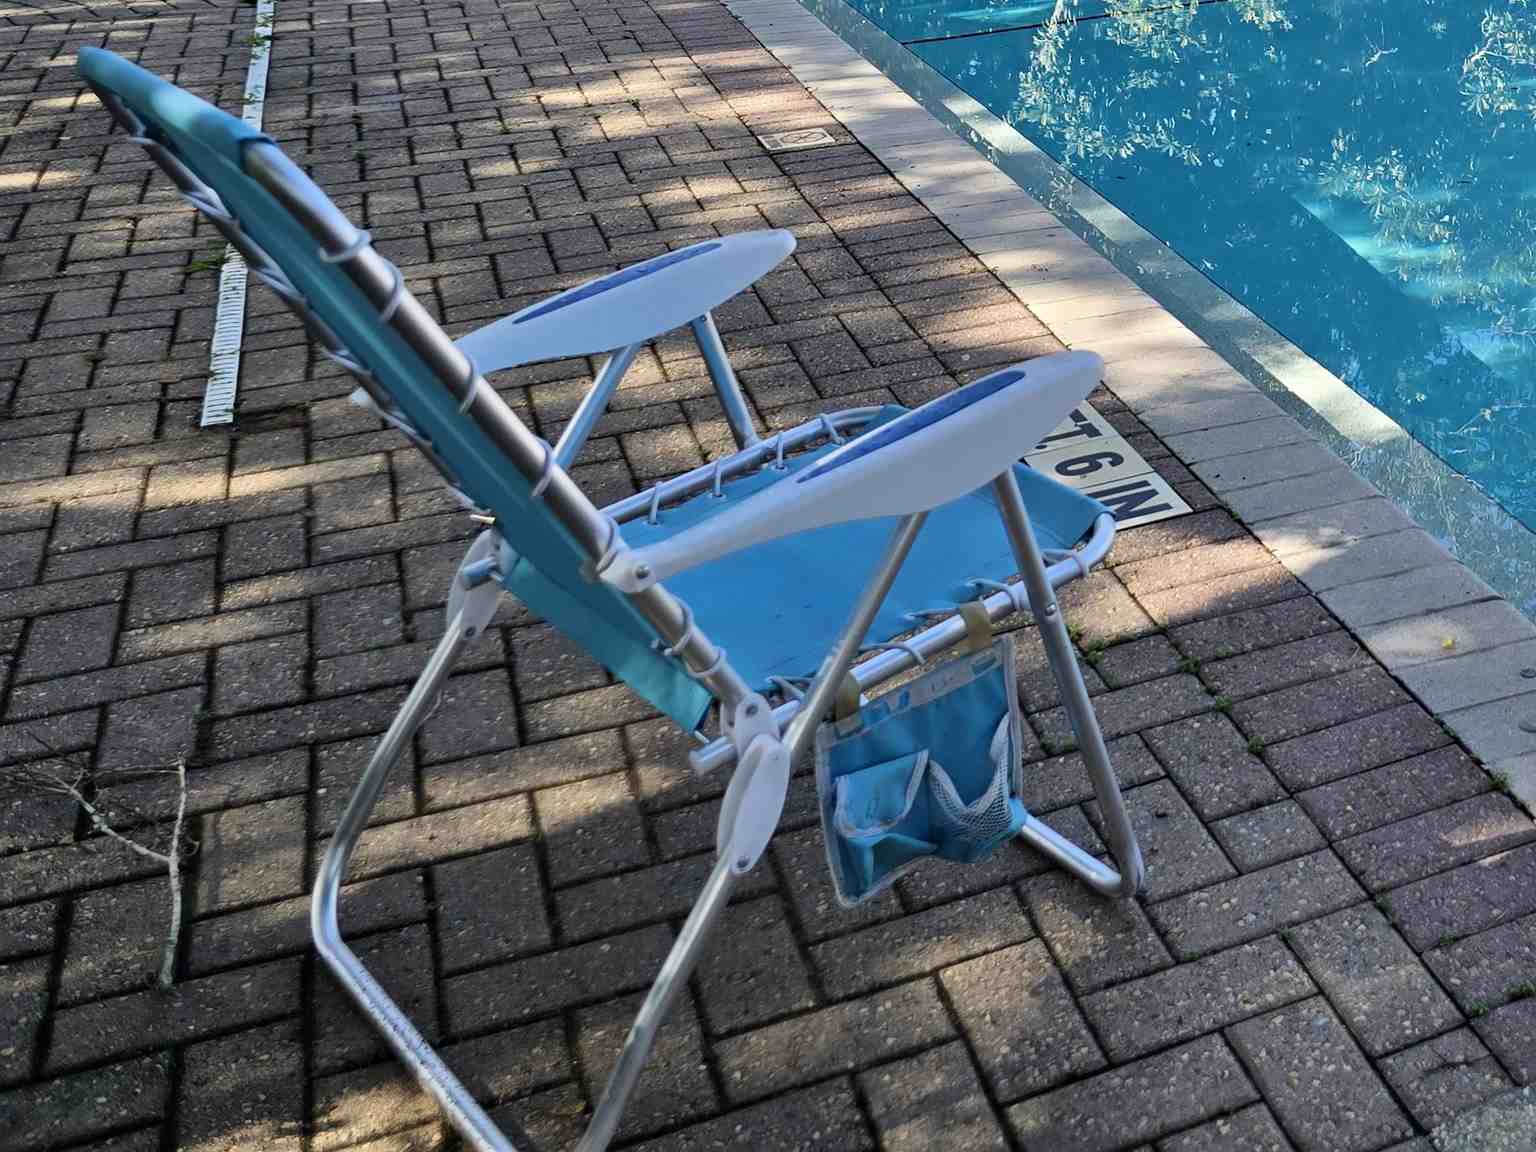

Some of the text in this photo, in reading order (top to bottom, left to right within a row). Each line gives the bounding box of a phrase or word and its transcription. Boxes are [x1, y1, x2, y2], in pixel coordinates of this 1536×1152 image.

[1034, 408, 1174, 522] T. 6 IN
